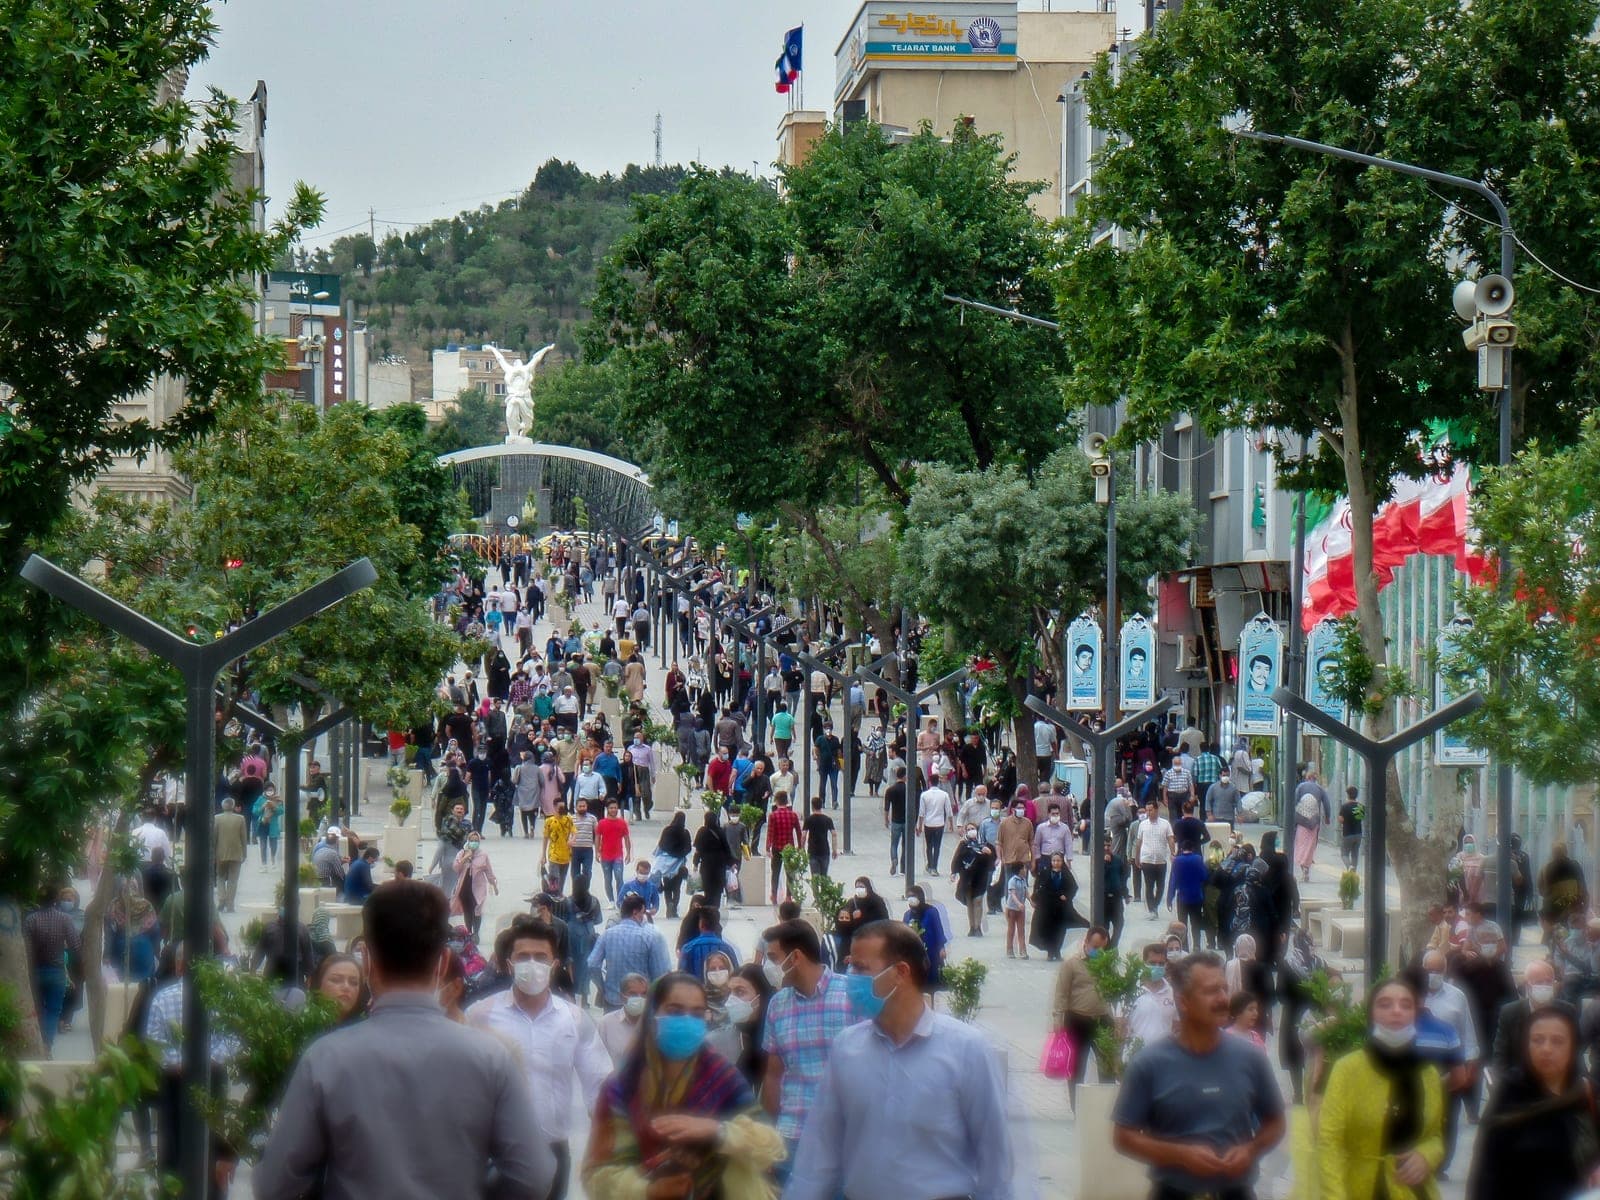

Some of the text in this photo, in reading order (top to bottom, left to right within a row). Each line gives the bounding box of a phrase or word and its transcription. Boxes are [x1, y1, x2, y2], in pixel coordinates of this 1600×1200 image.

[878, 12, 962, 41] بانک تجارت
[891, 44, 956, 52] TEJARAT BANK
